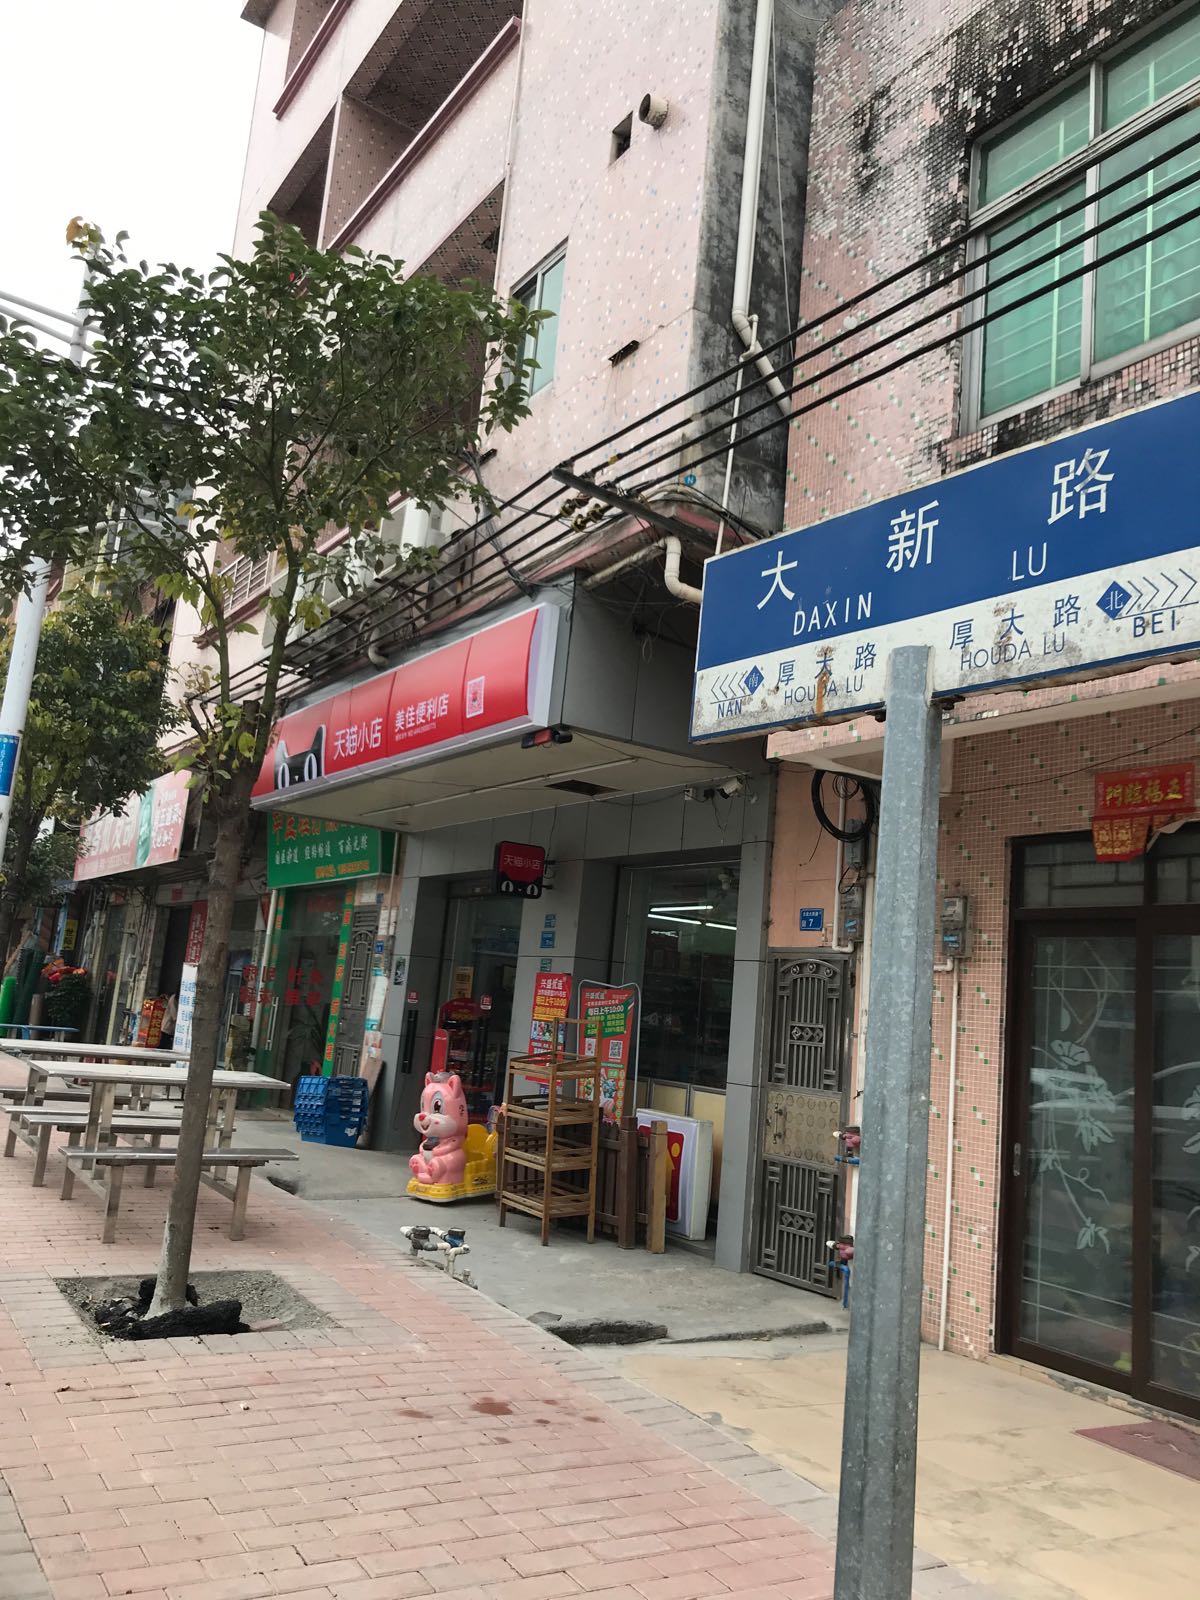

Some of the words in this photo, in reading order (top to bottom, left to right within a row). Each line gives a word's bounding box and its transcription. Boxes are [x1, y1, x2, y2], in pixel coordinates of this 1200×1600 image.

[756, 447, 1115, 610] 大新路
[792, 592, 873, 636] DAXIN
[1012, 543, 1048, 581] LU
[1105, 590, 1123, 611] 北
[949, 593, 1082, 650] 厚大路
[1133, 609, 1176, 638] BEI
[776, 642, 877, 687] 厚大路
[960, 641, 1031, 671] HOUDA
[1043, 632, 1066, 654] LU
[717, 699, 743, 719] NAN
[783, 680, 838, 706] HOUDA
[846, 675, 864, 694] LU
[395, 693, 450, 733] 美佳便利店
[333, 716, 383, 760] 天猫小店
[503, 853, 543, 871] 天猫小店
[809, 918, 814, 927] 7
